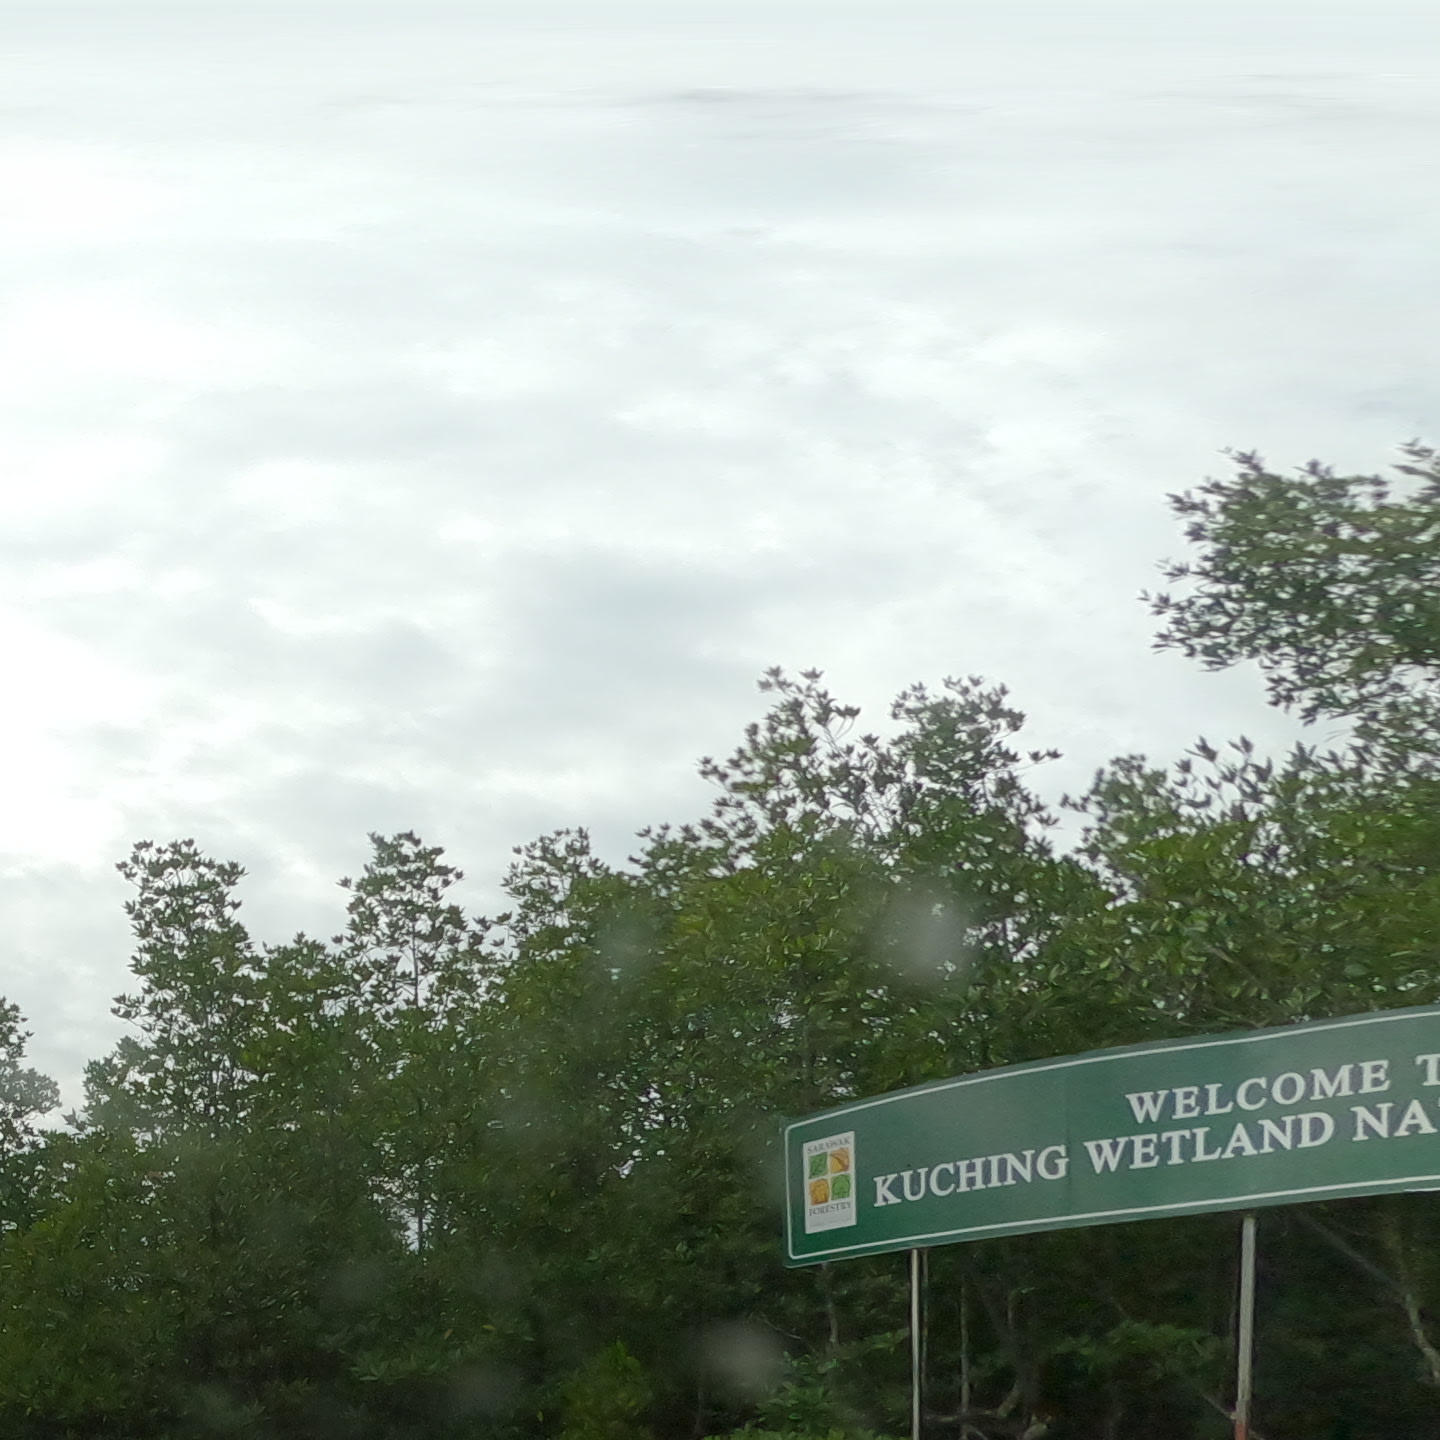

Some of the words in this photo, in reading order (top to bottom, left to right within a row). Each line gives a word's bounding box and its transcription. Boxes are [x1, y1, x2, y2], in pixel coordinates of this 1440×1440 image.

[1126, 1059, 1393, 1125] WELCOME
[873, 1144, 1069, 1208] KUCHING
[1084, 1111, 1336, 1175] WETLAND
[809, 1202, 851, 1216] FORESTRY
